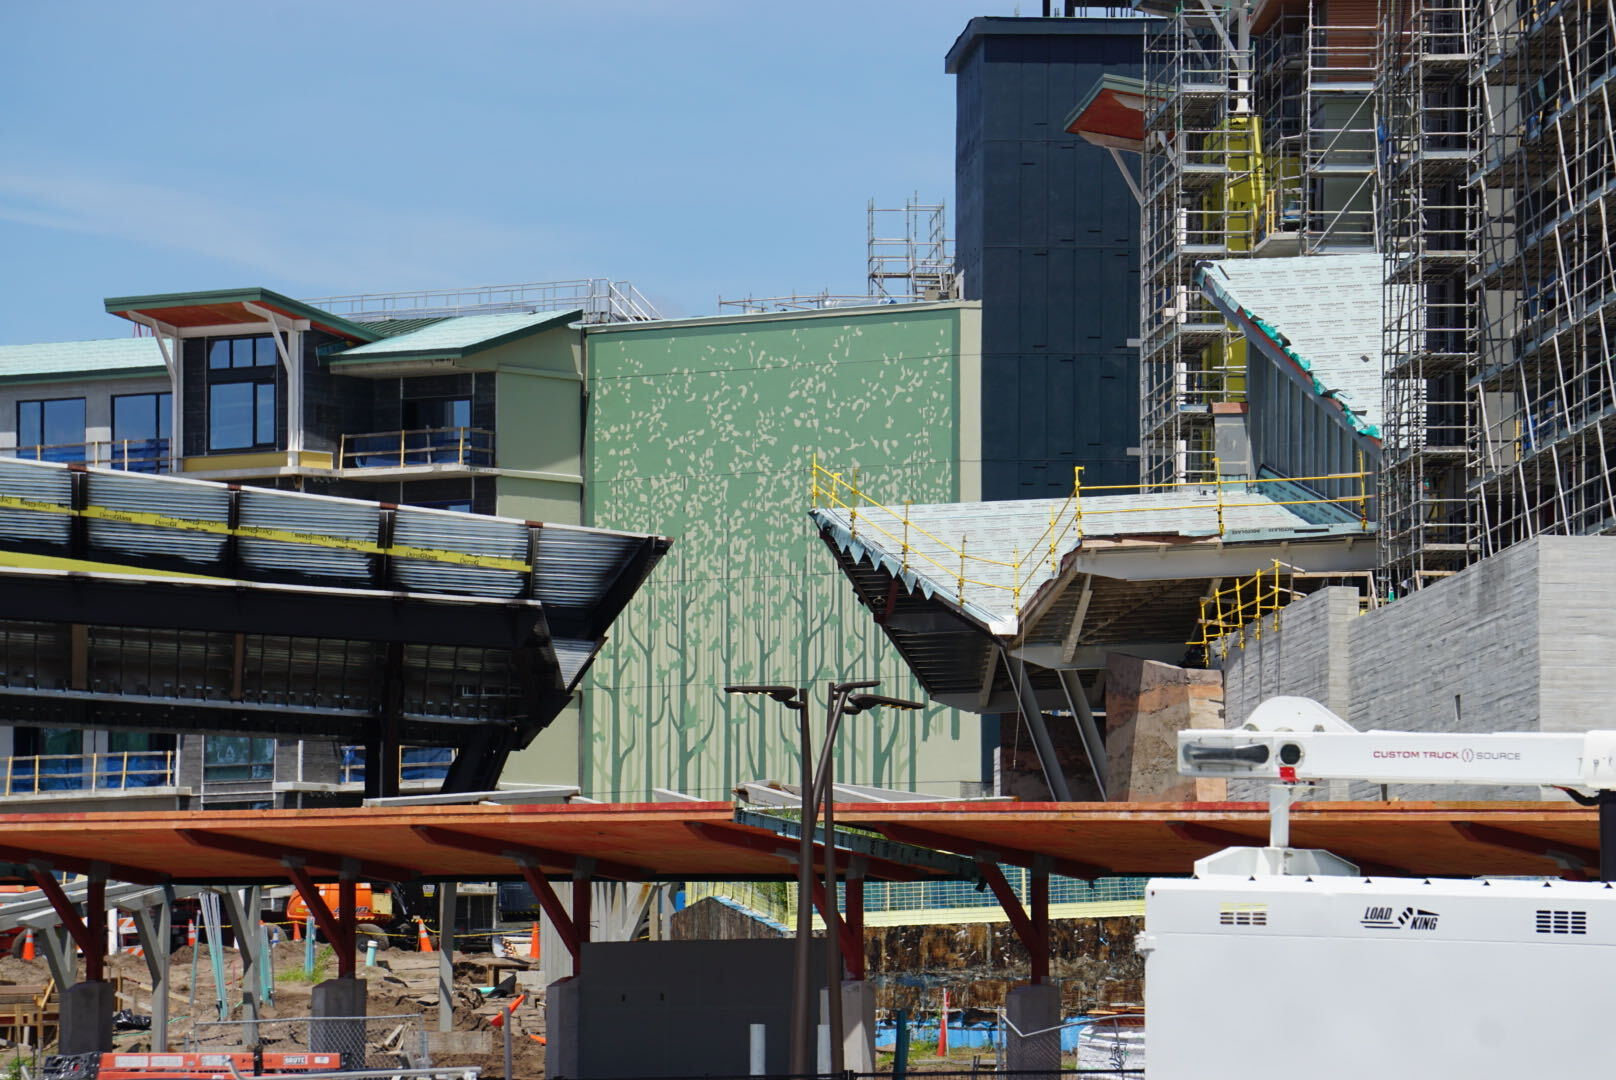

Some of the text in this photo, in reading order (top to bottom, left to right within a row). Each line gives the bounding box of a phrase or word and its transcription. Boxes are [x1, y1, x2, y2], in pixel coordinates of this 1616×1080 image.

[1373, 750, 1420, 759] CUSTOM
[1423, 751, 1459, 760] TRUCK
[1476, 752, 1521, 760] SOURCE
[1364, 906, 1438, 931] LOAD KING
